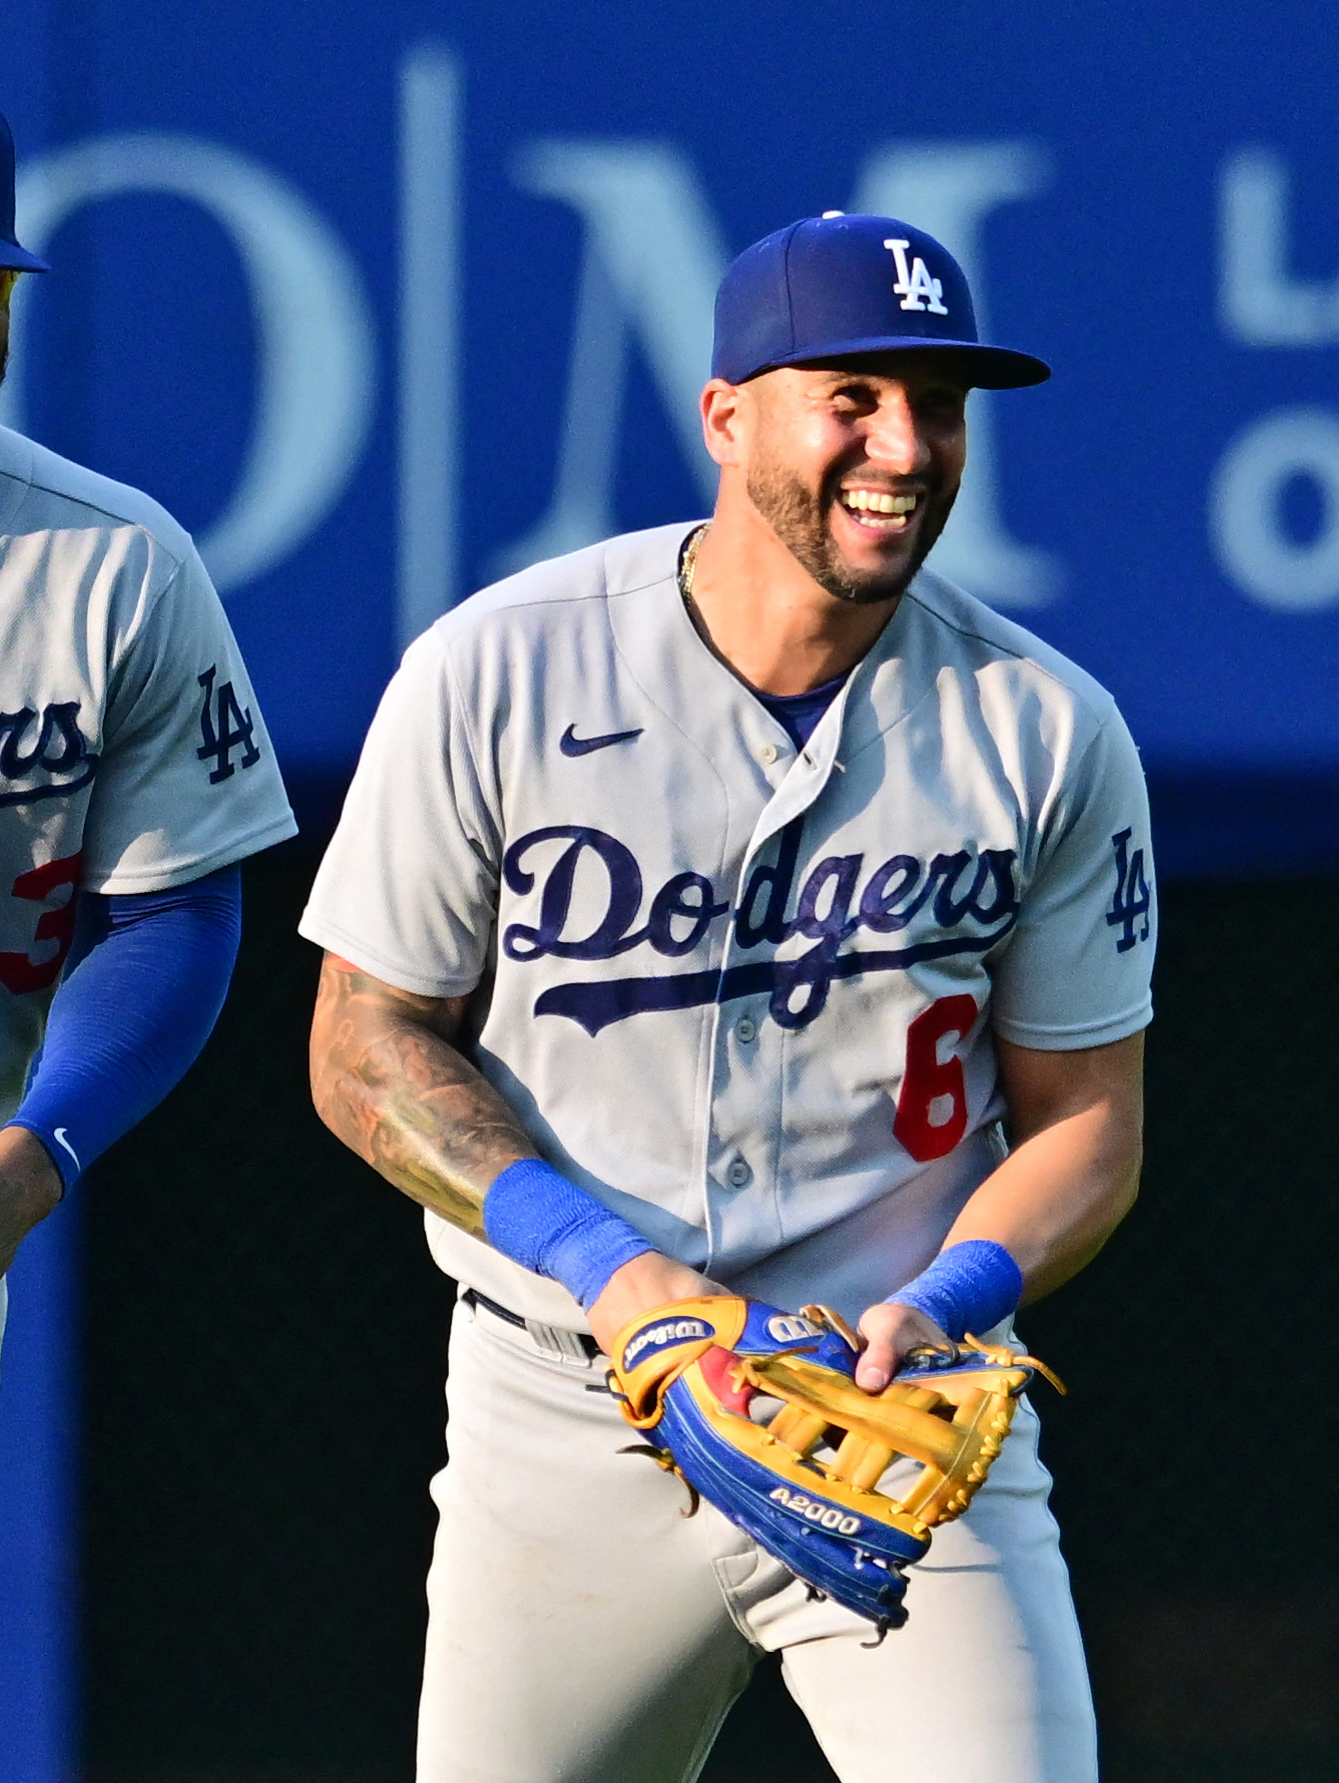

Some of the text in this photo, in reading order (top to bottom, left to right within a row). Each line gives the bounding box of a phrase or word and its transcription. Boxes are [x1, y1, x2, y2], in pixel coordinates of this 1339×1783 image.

[883, 238, 948, 315] LA
[196, 663, 262, 785] LA
[502, 815, 1021, 1034] Dodgers
[1106, 826, 1150, 954] LA
[892, 993, 978, 1162] 6
[624, 1320, 706, 1361] Wilson
[769, 1487, 861, 1535] A2000
